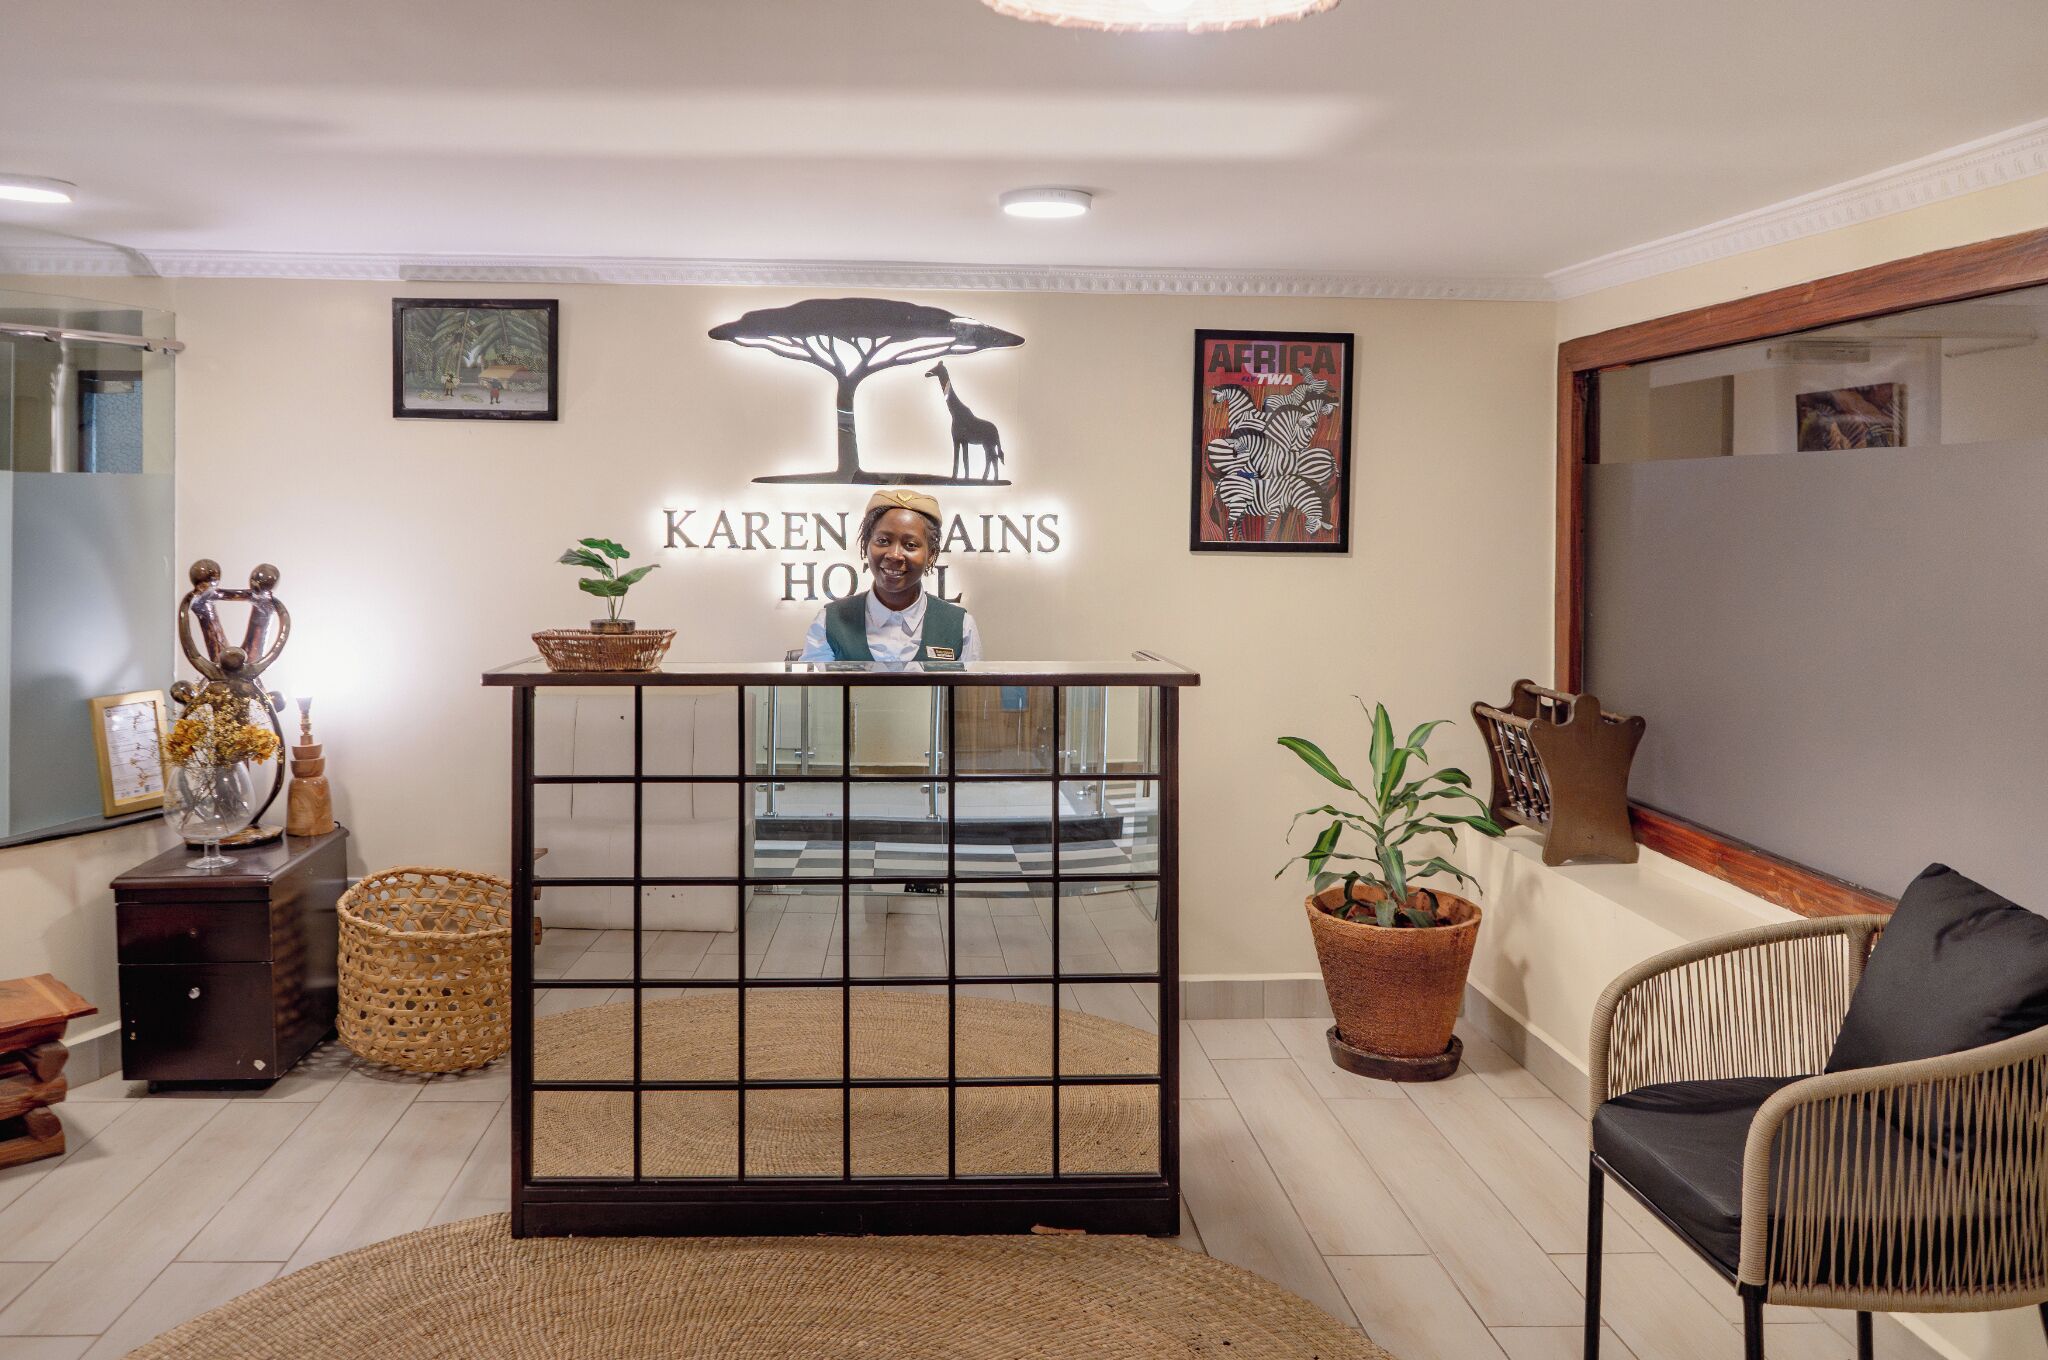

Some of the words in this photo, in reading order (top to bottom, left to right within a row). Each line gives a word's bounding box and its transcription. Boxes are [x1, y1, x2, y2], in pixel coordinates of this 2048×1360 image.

[1208, 343, 1337, 374] AFRICA
[1256, 373, 1293, 386] TWA
[663, 508, 849, 551] KAREN
[940, 513, 1061, 554] AINS
[780, 561, 963, 604] HOL
